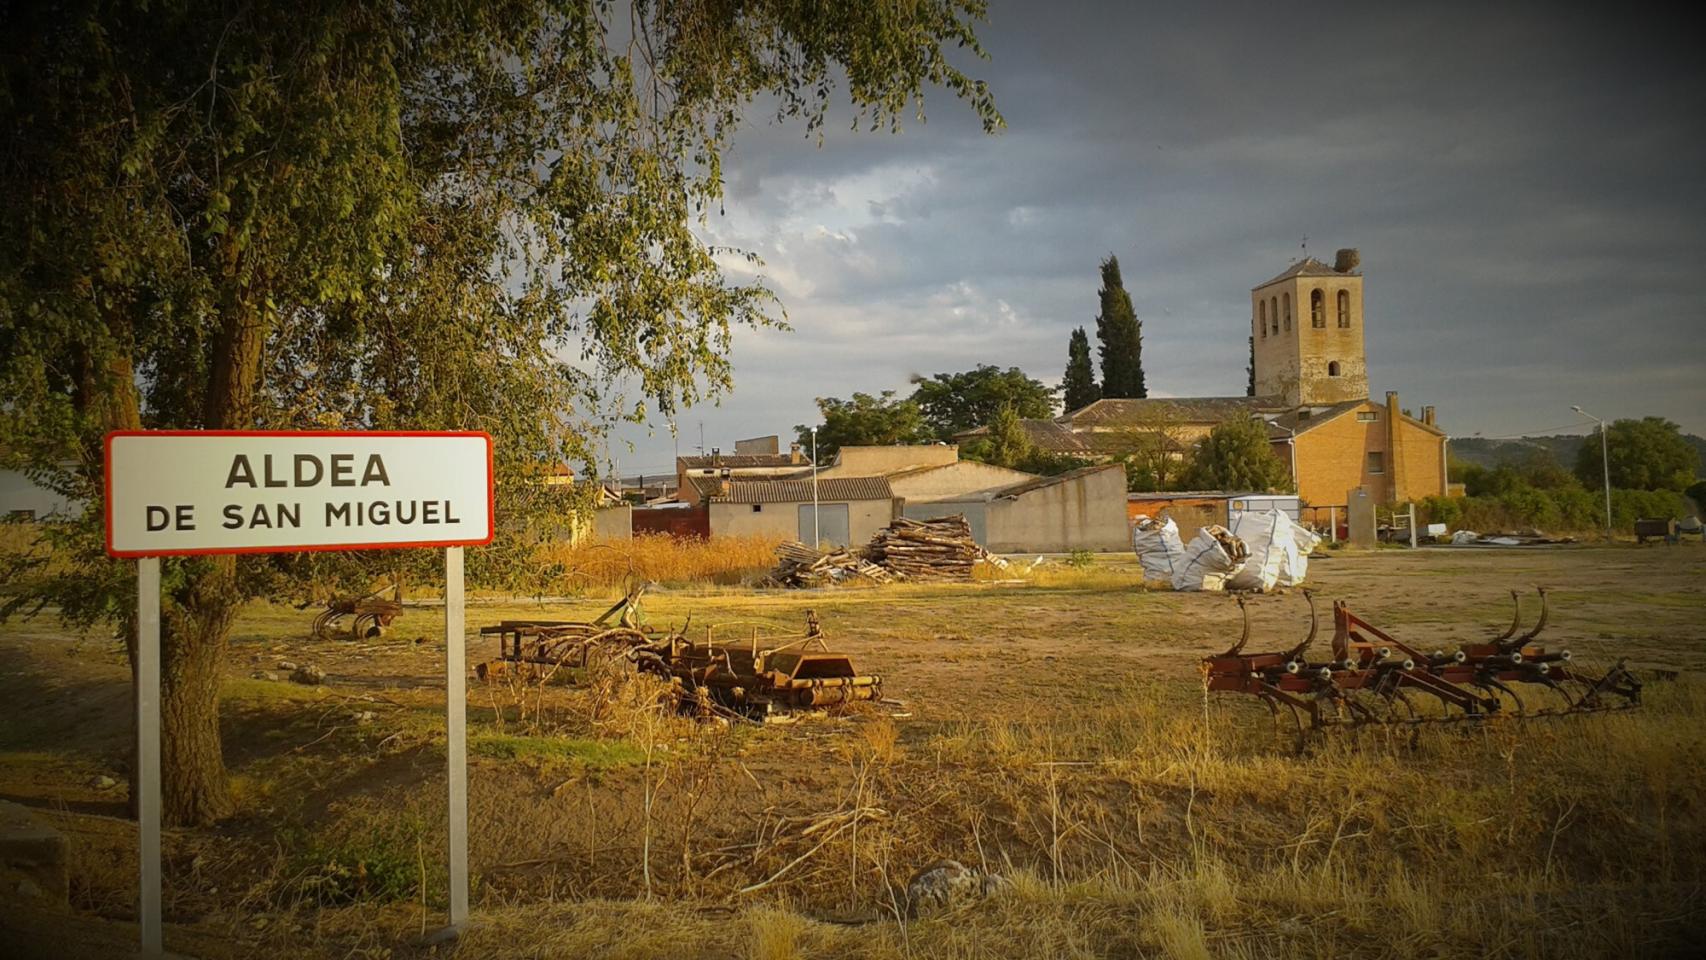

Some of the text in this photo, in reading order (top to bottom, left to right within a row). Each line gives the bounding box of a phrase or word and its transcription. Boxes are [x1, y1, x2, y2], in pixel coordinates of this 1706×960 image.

[225, 453, 391, 488] ALDEA
[146, 500, 461, 532] DE SAN MIGUEL
